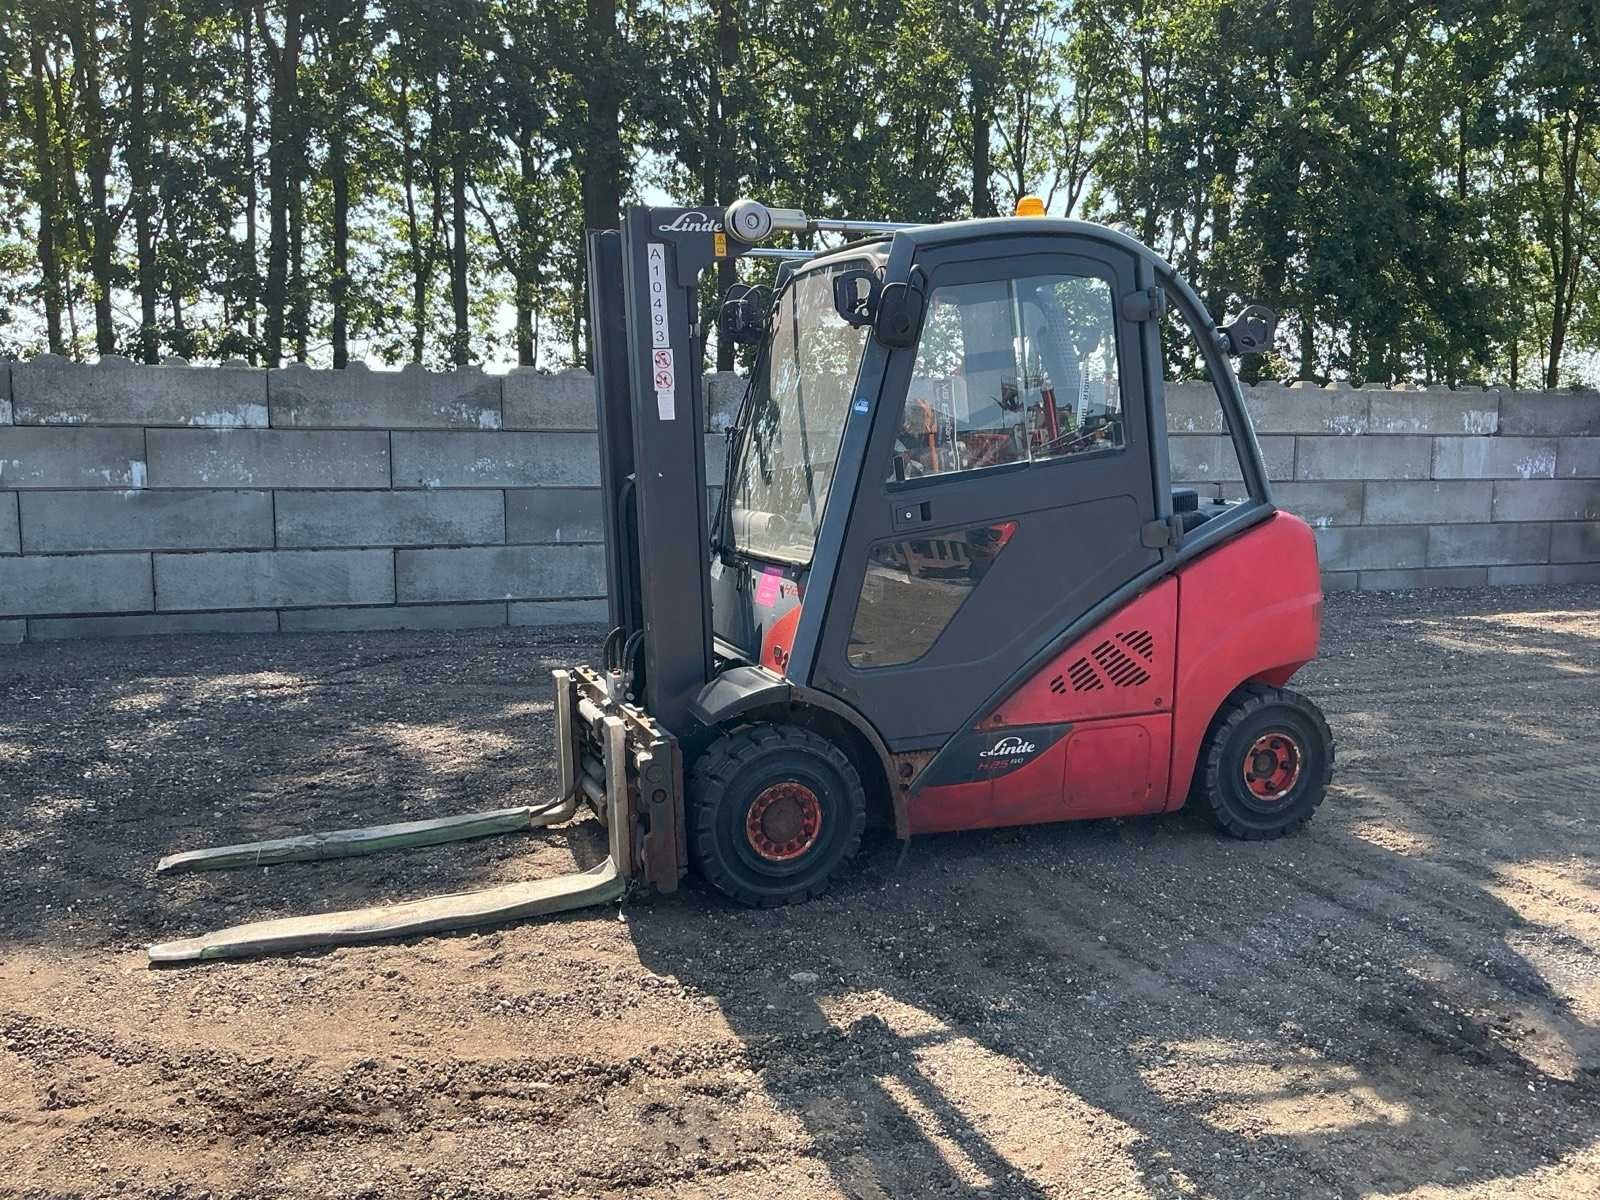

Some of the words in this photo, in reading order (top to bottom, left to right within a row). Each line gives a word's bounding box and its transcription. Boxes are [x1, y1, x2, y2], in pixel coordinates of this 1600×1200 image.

[659, 211, 723, 232] Linde
[650, 250, 665, 342] A10493
[980, 736, 1035, 757] Linde
